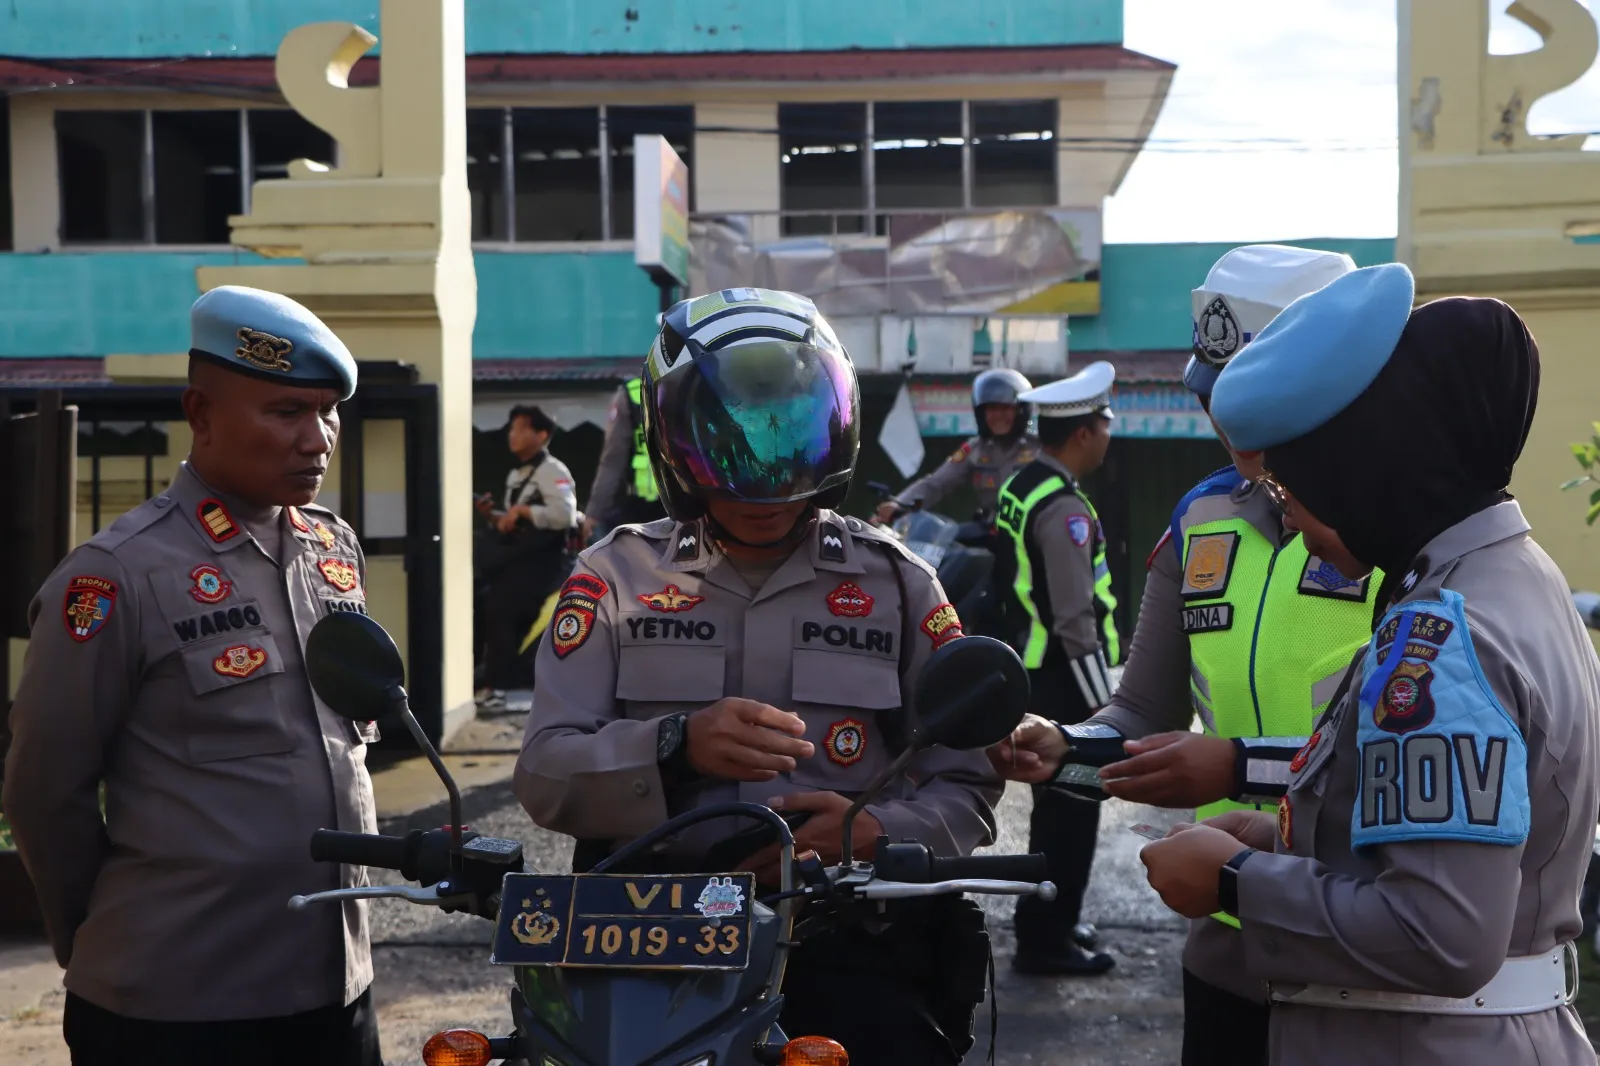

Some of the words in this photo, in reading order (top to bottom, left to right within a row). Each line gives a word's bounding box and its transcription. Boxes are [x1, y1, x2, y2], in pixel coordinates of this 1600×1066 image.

[77, 578, 111, 590] PROPAM
[627, 617, 716, 641] YETNO
[1187, 607, 1222, 628] DINA
[802, 622, 893, 654] POLRI
[1357, 733, 1508, 828] ROV
[624, 882, 682, 909] VI
